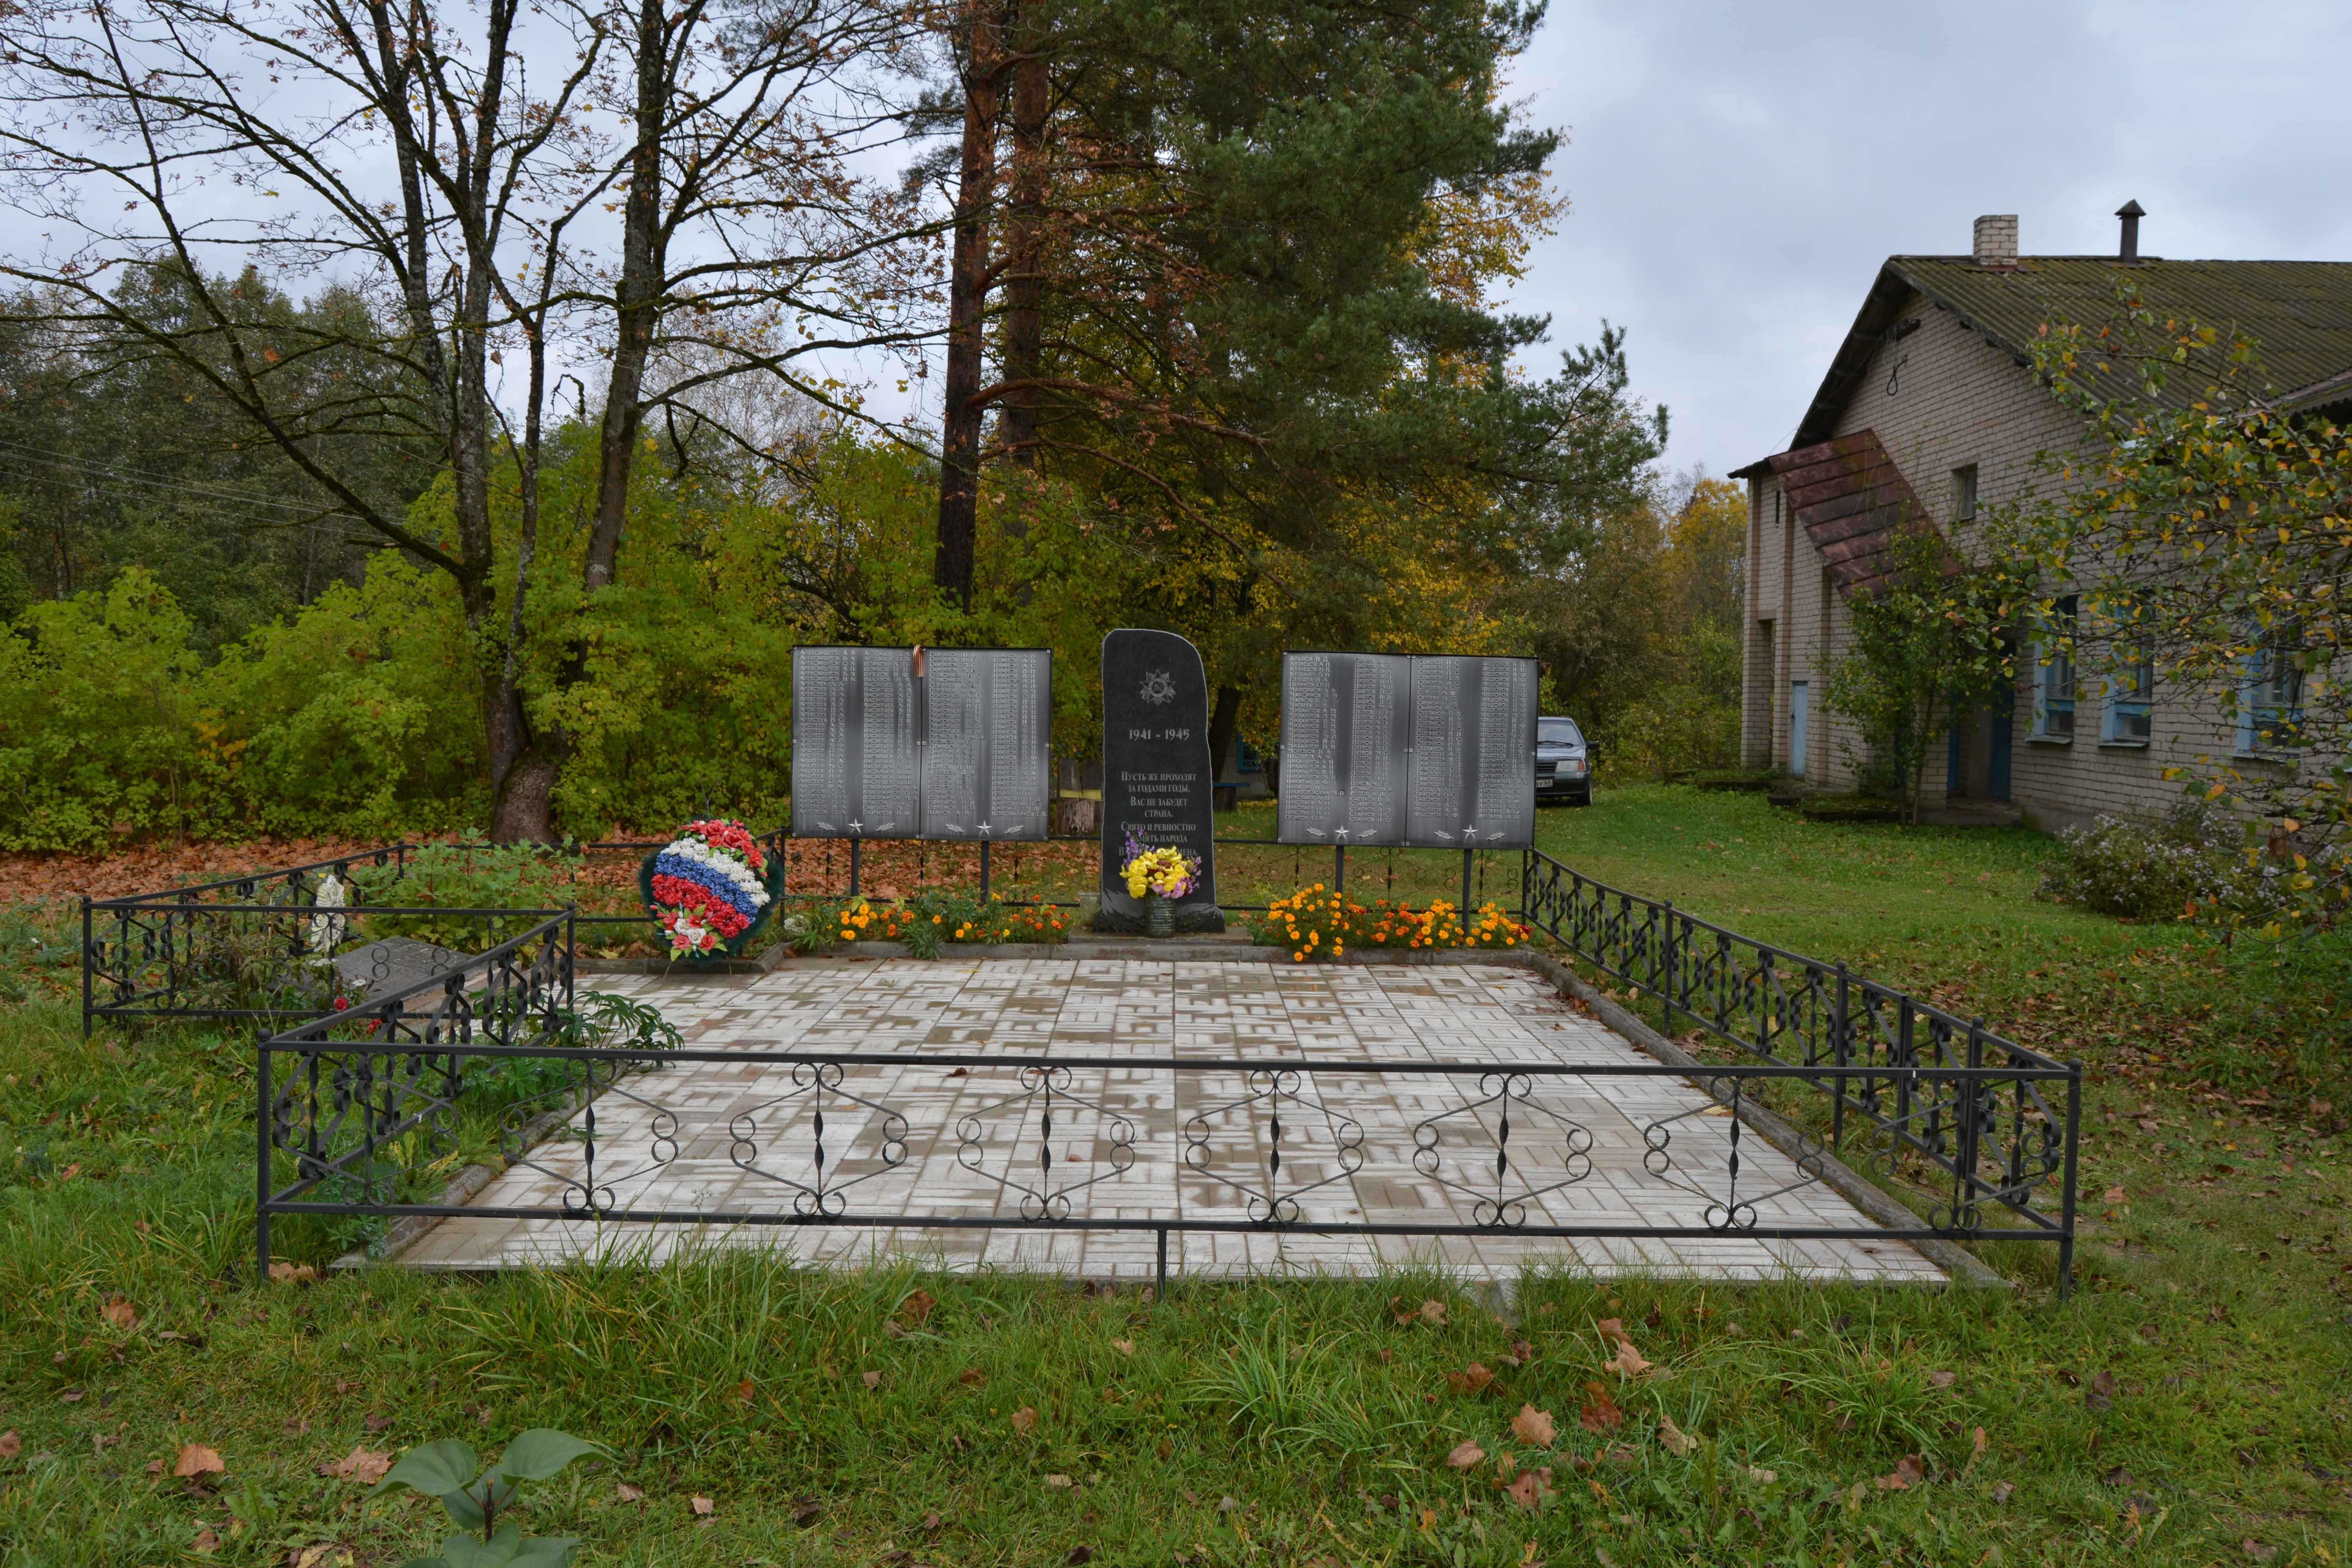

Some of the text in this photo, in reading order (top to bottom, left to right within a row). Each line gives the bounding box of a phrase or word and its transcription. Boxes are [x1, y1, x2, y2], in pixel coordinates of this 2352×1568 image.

[1129, 728, 1151, 741] 1941
[1165, 728, 1190, 741] 1945
[1121, 771, 1146, 781] ПУСТЬ
[1138, 785, 1167, 793] ГОДАМИ
[1169, 785, 1190, 793] ГОДЫ,
[1131, 797, 1146, 806] ВАС
[1158, 799, 1188, 807] ЗАБУДЕТ
